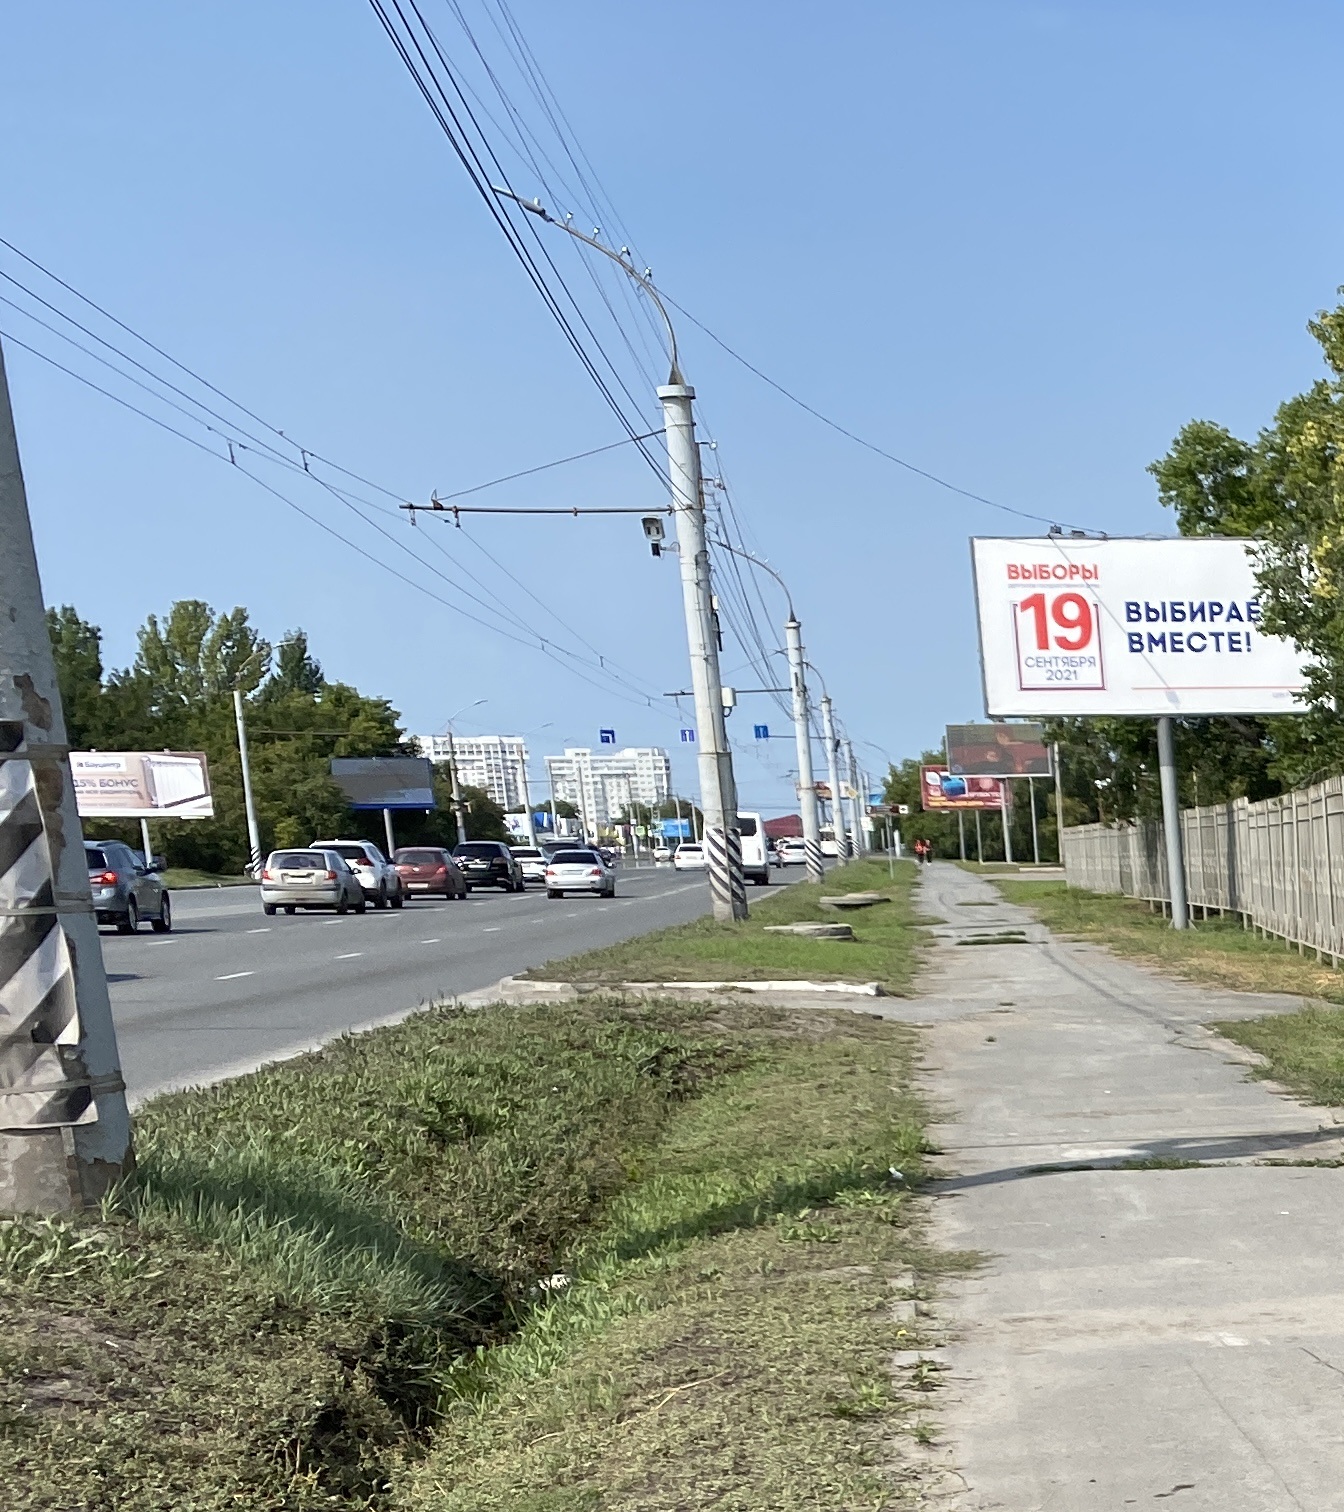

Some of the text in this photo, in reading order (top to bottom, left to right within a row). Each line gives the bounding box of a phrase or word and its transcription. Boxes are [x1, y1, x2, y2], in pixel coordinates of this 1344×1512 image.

[1007, 563, 1099, 580] ВЫБОРЫ
[1125, 600, 1261, 623] ВЫБИРАЕ
[1020, 592, 1092, 651] 19
[1127, 631, 1252, 653] ВМЕСТЕ!
[1024, 656, 1097, 668] СЕНТЯБРЯ
[1045, 669, 1079, 681] 2021
[99, 778, 139, 788] БОНУС
